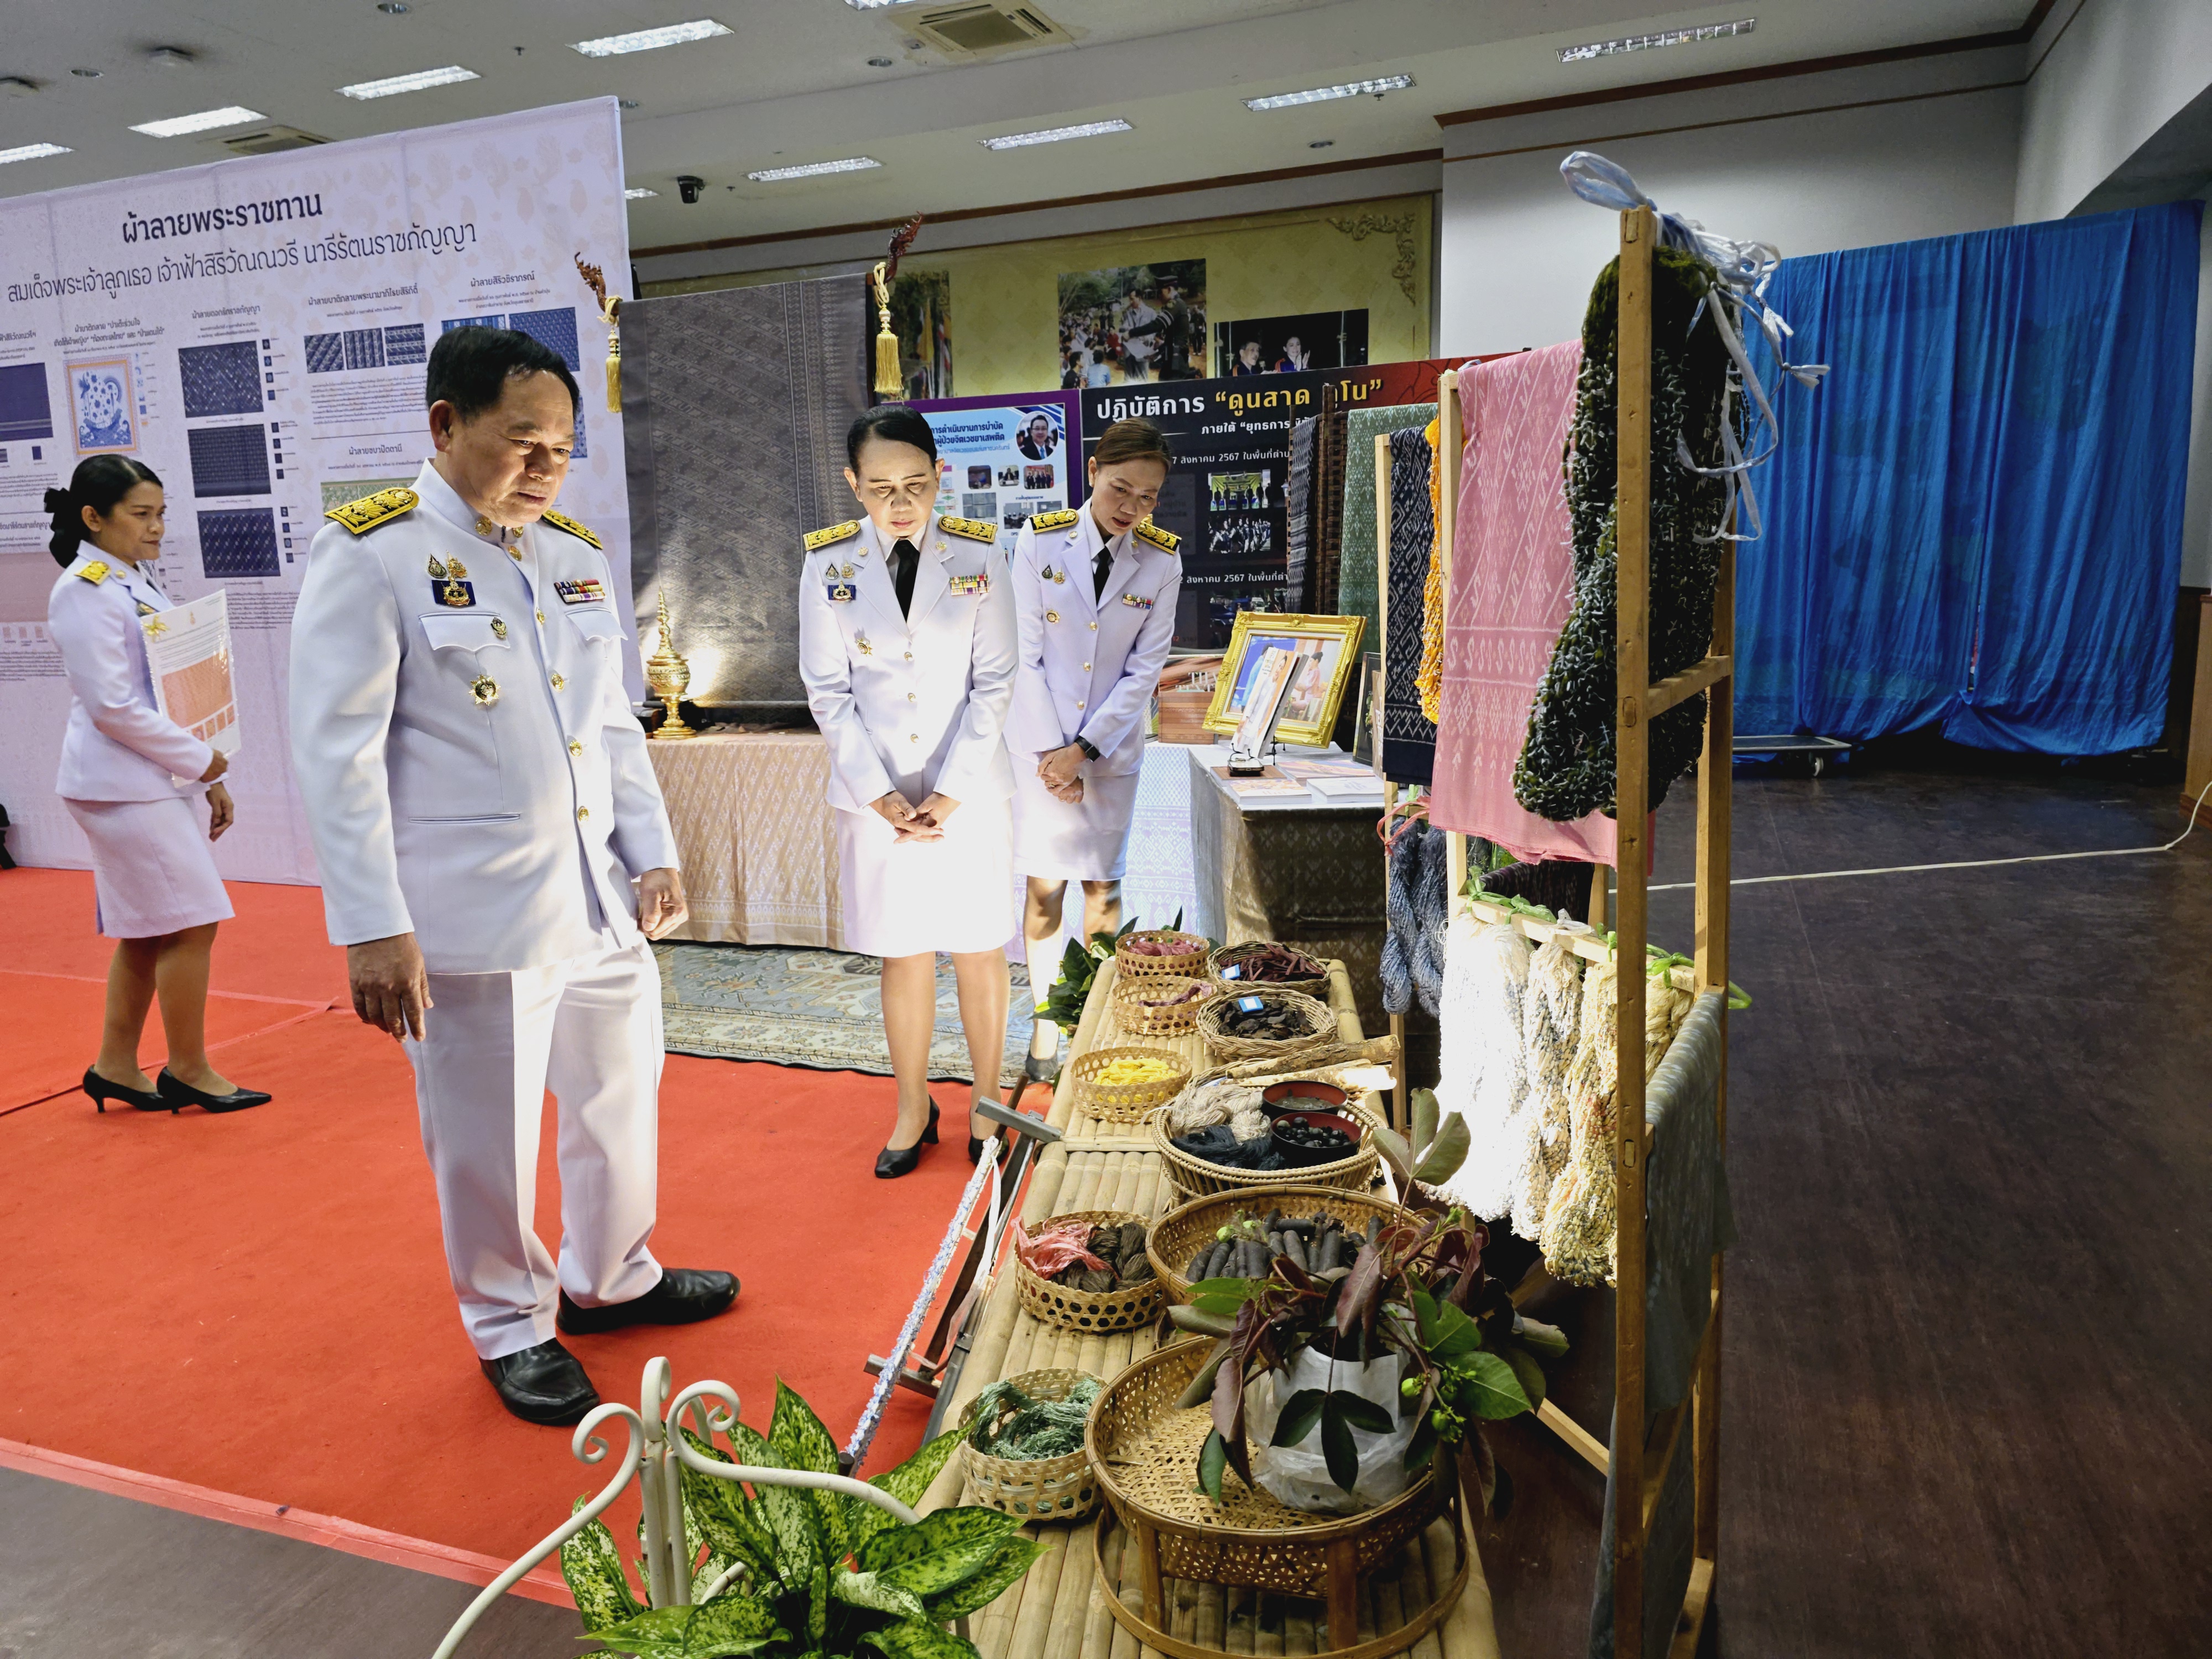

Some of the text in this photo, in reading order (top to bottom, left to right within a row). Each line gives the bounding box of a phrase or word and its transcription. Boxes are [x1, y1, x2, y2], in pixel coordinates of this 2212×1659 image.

[122, 192, 323, 244] ผ้าลายพระราชทาน
[7, 222, 477, 302] สมเด็จพระเจ้าลูกเธอ เจ้าฟ้าสิริวัณณวรี นารีรัตนราชกัญญา
[470, 270, 535, 288] ผ้าลายสิริวชิราภรณ์
[1097, 395, 1205, 422] ปฏิบัติการ
[1201, 421, 1237, 435] ภายใต้
[1180, 455, 1215, 464] สิงหาคม
[1218, 452, 1239, 462] 2567
[1187, 575, 1220, 584] สิงหาคม
[1224, 574, 1244, 583] 2567
